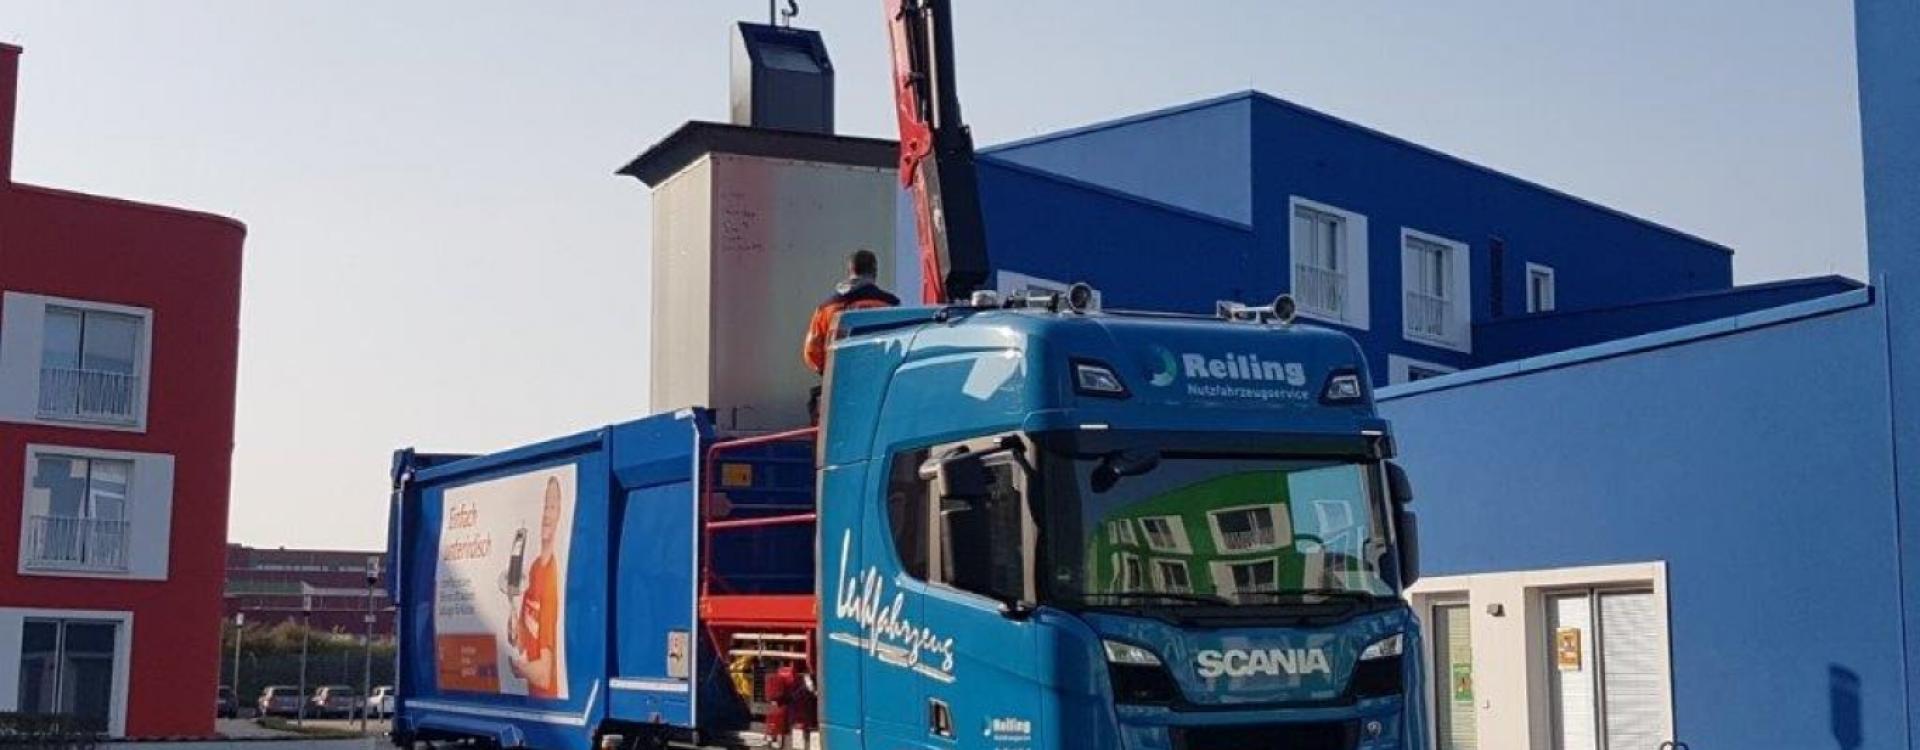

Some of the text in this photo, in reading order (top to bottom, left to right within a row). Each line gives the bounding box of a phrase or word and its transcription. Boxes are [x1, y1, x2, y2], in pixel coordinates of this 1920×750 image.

[1182, 352, 1306, 385] Reiling
[1187, 383, 1309, 400] Nutzfahrzeugservice
[1198, 649, 1331, 678] SCANIA
